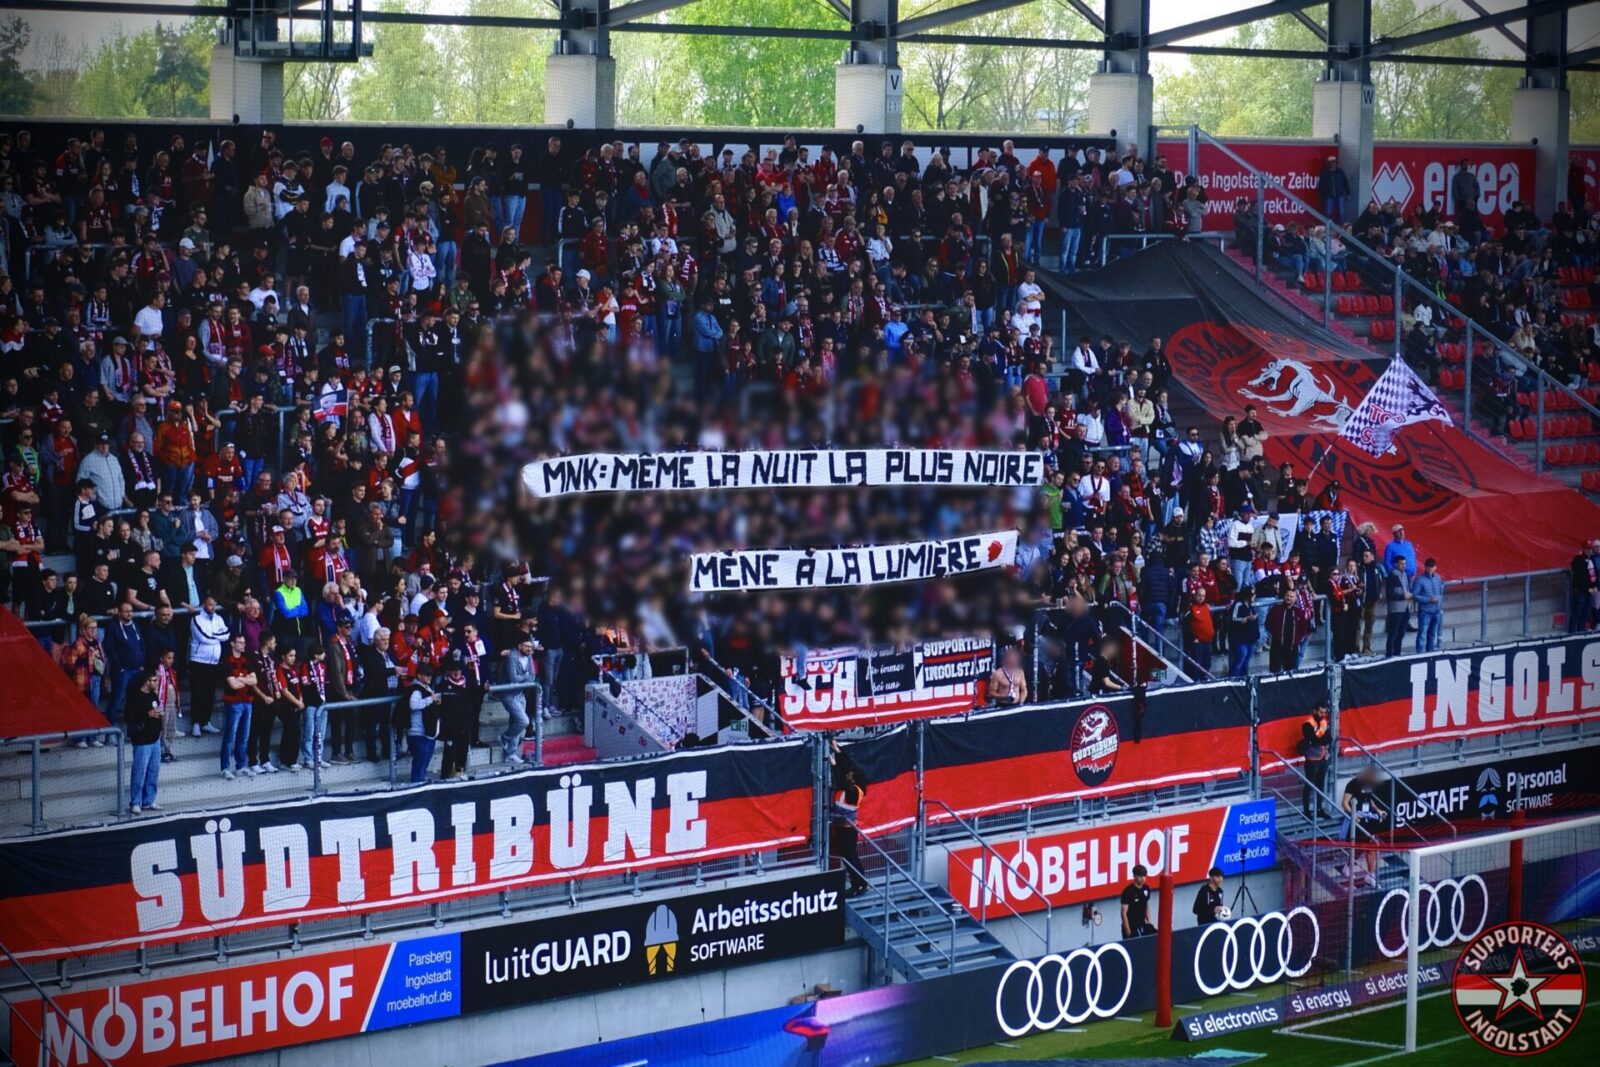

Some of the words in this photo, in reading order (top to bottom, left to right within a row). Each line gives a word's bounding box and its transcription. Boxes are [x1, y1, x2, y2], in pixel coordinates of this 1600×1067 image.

[706, 454, 740, 487] LA
[751, 452, 818, 485] NUIT
[829, 451, 867, 484] LA
[886, 451, 953, 483] PLUS
[963, 453, 1041, 484] NOIRE
[825, 552, 861, 584] LA
[1239, 811, 1269, 826] Parsberg
[1396, 785, 1470, 828] guSTAFF
[1236, 827, 1270, 845] Ingolstadt
[131, 770, 708, 933] SÜDTRIBÜNE
[691, 888, 838, 934] Arbeitsschutz
[409, 950, 452, 967] Parsberg
[485, 930, 631, 985] luitGUARD
[690, 933, 765, 963] SOFTWARE
[405, 968, 452, 990] Ingolstadt
[1365, 979, 1376, 995] si
[386, 989, 452, 1012] moebelhof.de
[1292, 995, 1304, 1013] si
[1306, 988, 1352, 1011] energy
[1188, 1019, 1203, 1036] si
[1204, 1005, 1278, 1033] electronics
